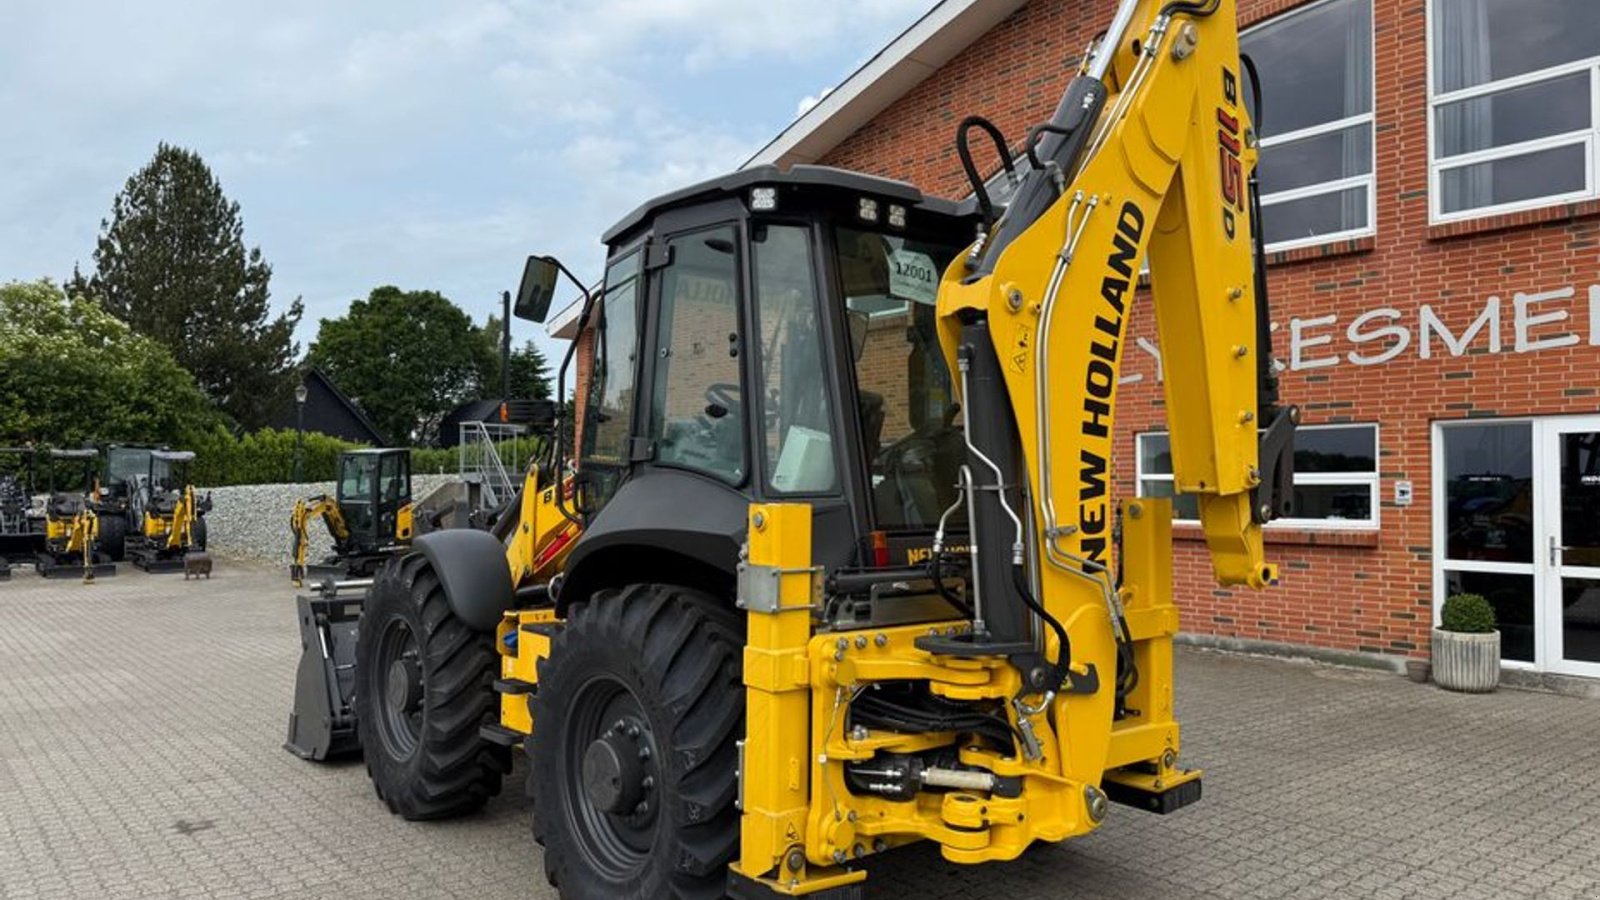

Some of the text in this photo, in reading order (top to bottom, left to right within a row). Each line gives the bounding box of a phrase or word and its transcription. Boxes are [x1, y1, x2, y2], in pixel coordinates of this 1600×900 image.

[1223, 66, 1237, 107] B
[1217, 107, 1245, 213] 115
[895, 261, 932, 283] 12001
[1080, 200, 1146, 574] NEW HOLLAND
